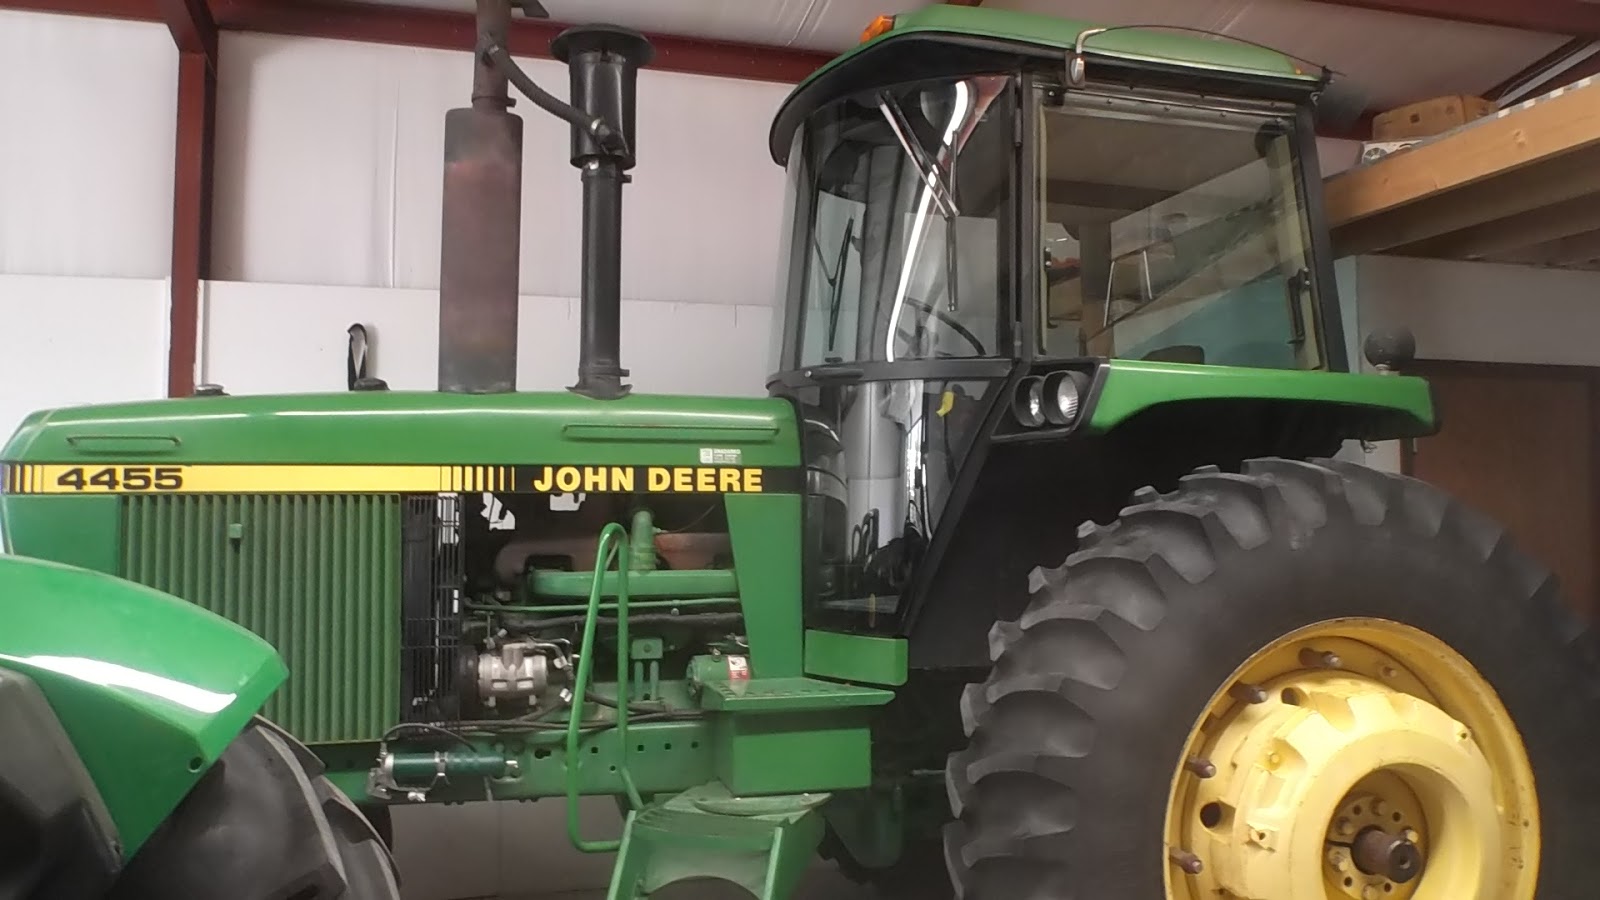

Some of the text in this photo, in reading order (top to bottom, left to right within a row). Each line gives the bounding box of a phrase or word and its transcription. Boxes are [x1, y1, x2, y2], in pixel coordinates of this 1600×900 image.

[57, 467, 183, 491] 4455
[533, 466, 763, 492] JOHN DEERE
